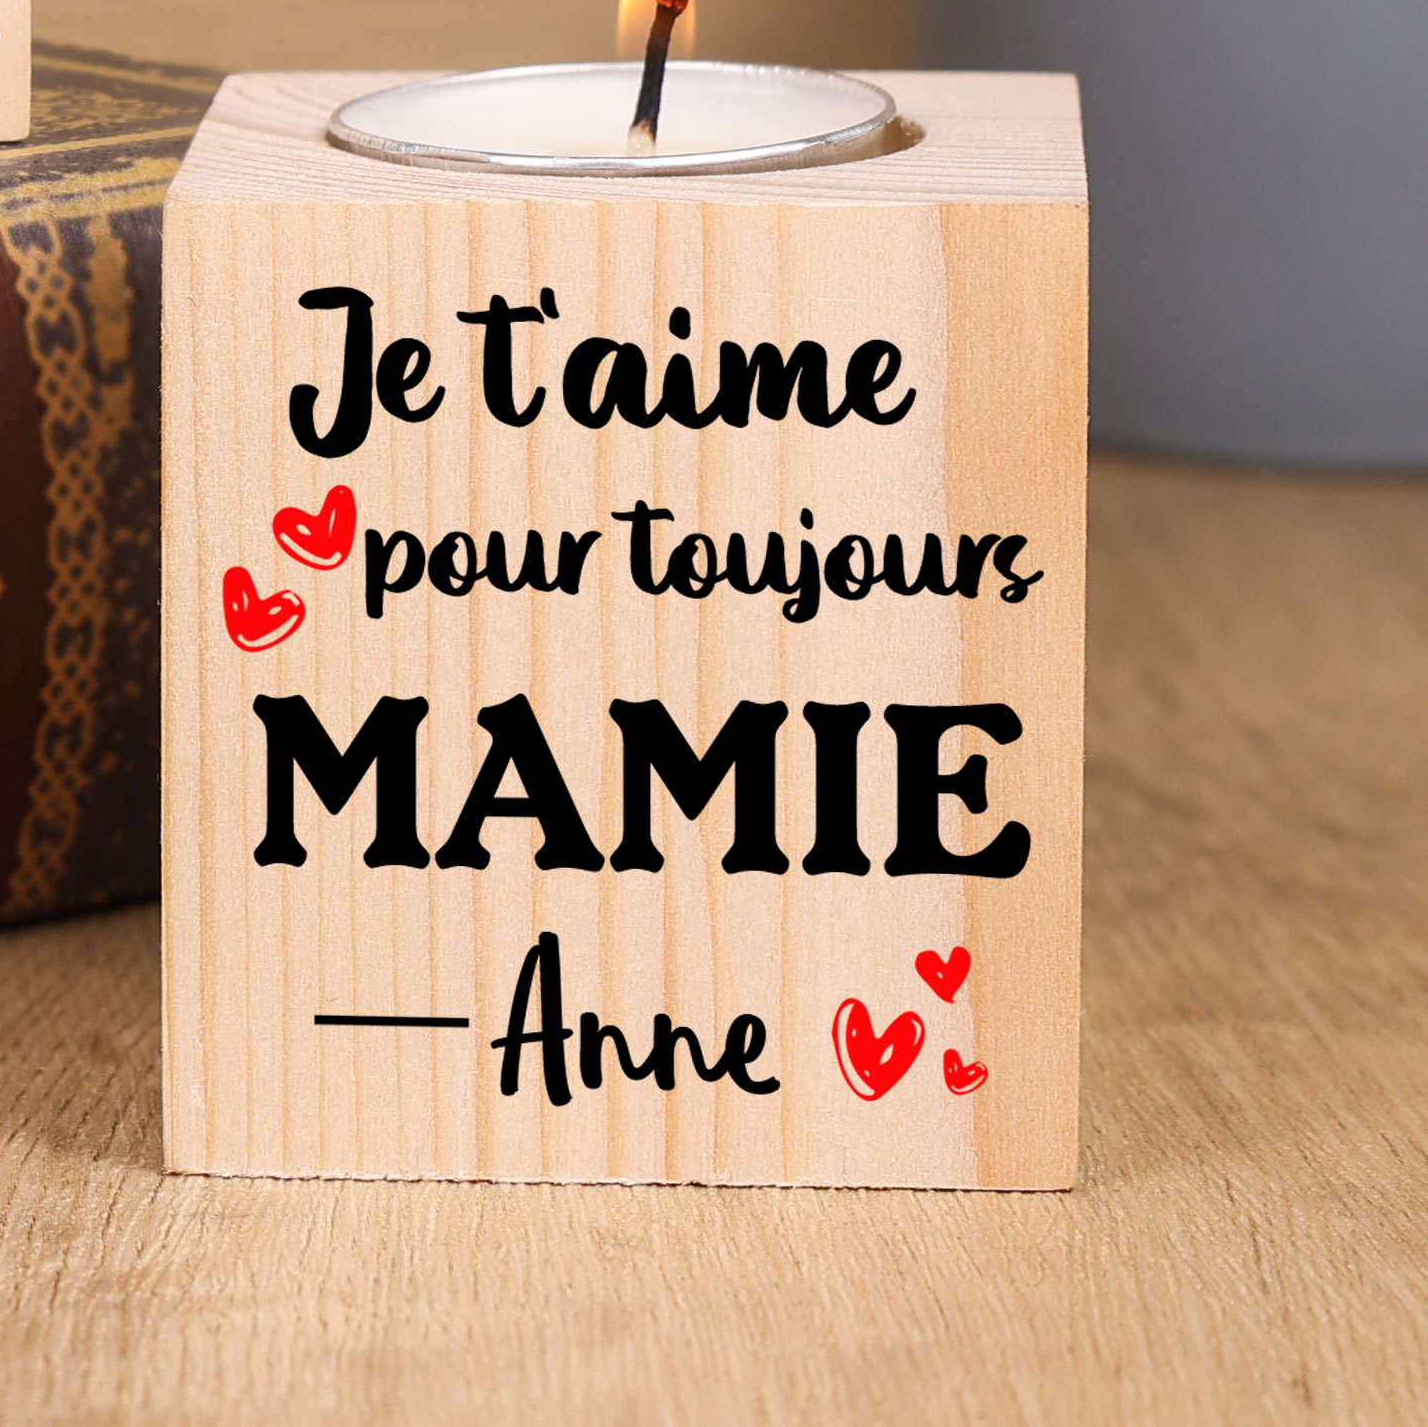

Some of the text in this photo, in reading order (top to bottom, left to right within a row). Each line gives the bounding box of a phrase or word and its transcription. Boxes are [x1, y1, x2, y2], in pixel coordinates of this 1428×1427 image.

[289, 286, 917, 459] Je t'aime
[365, 499, 1045, 624] pour toujours
[253, 693, 1031, 879] MAMIE
[490, 931, 781, 1107] Anne
